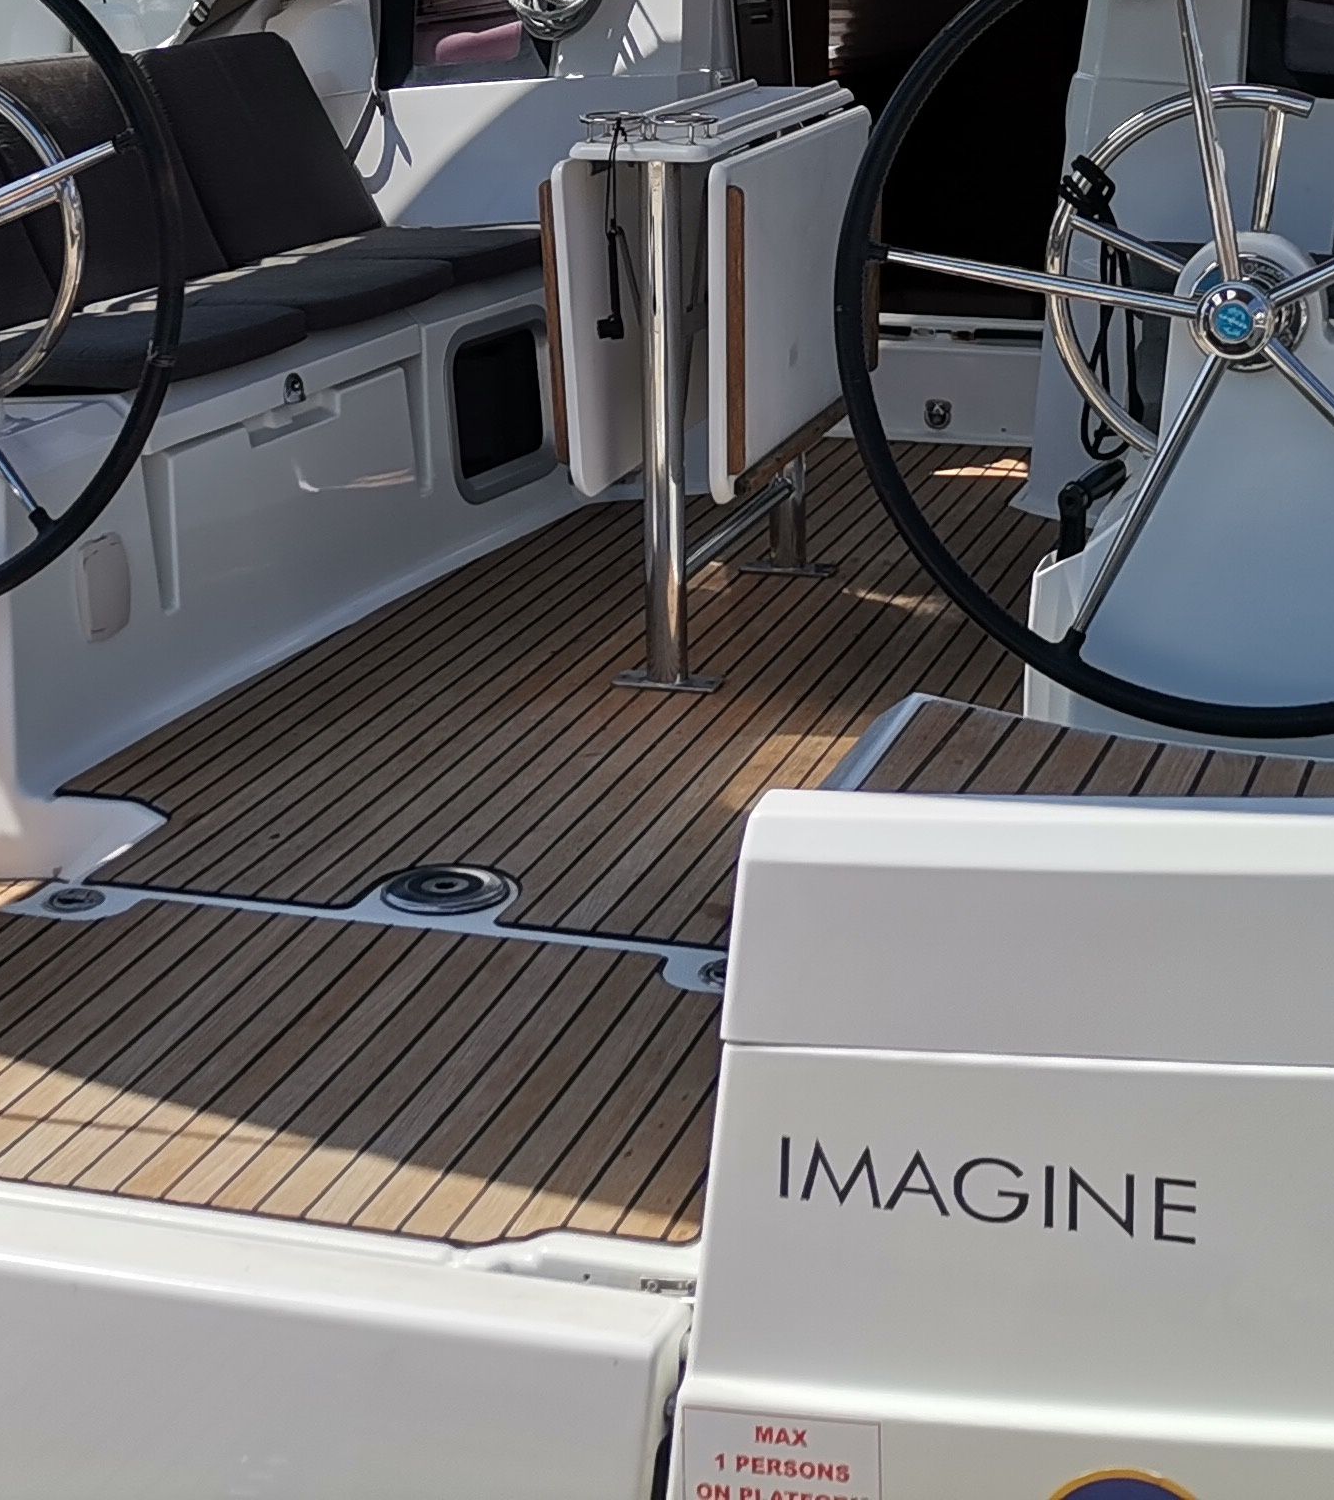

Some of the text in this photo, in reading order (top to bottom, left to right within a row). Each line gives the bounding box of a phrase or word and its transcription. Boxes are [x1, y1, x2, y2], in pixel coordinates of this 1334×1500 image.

[779, 1135, 1198, 1245] IMAGINE
[754, 1425, 808, 1448] MAX
[714, 1453, 851, 1483] 1 PERSONS
[696, 1482, 869, 1500] ON PLAT
